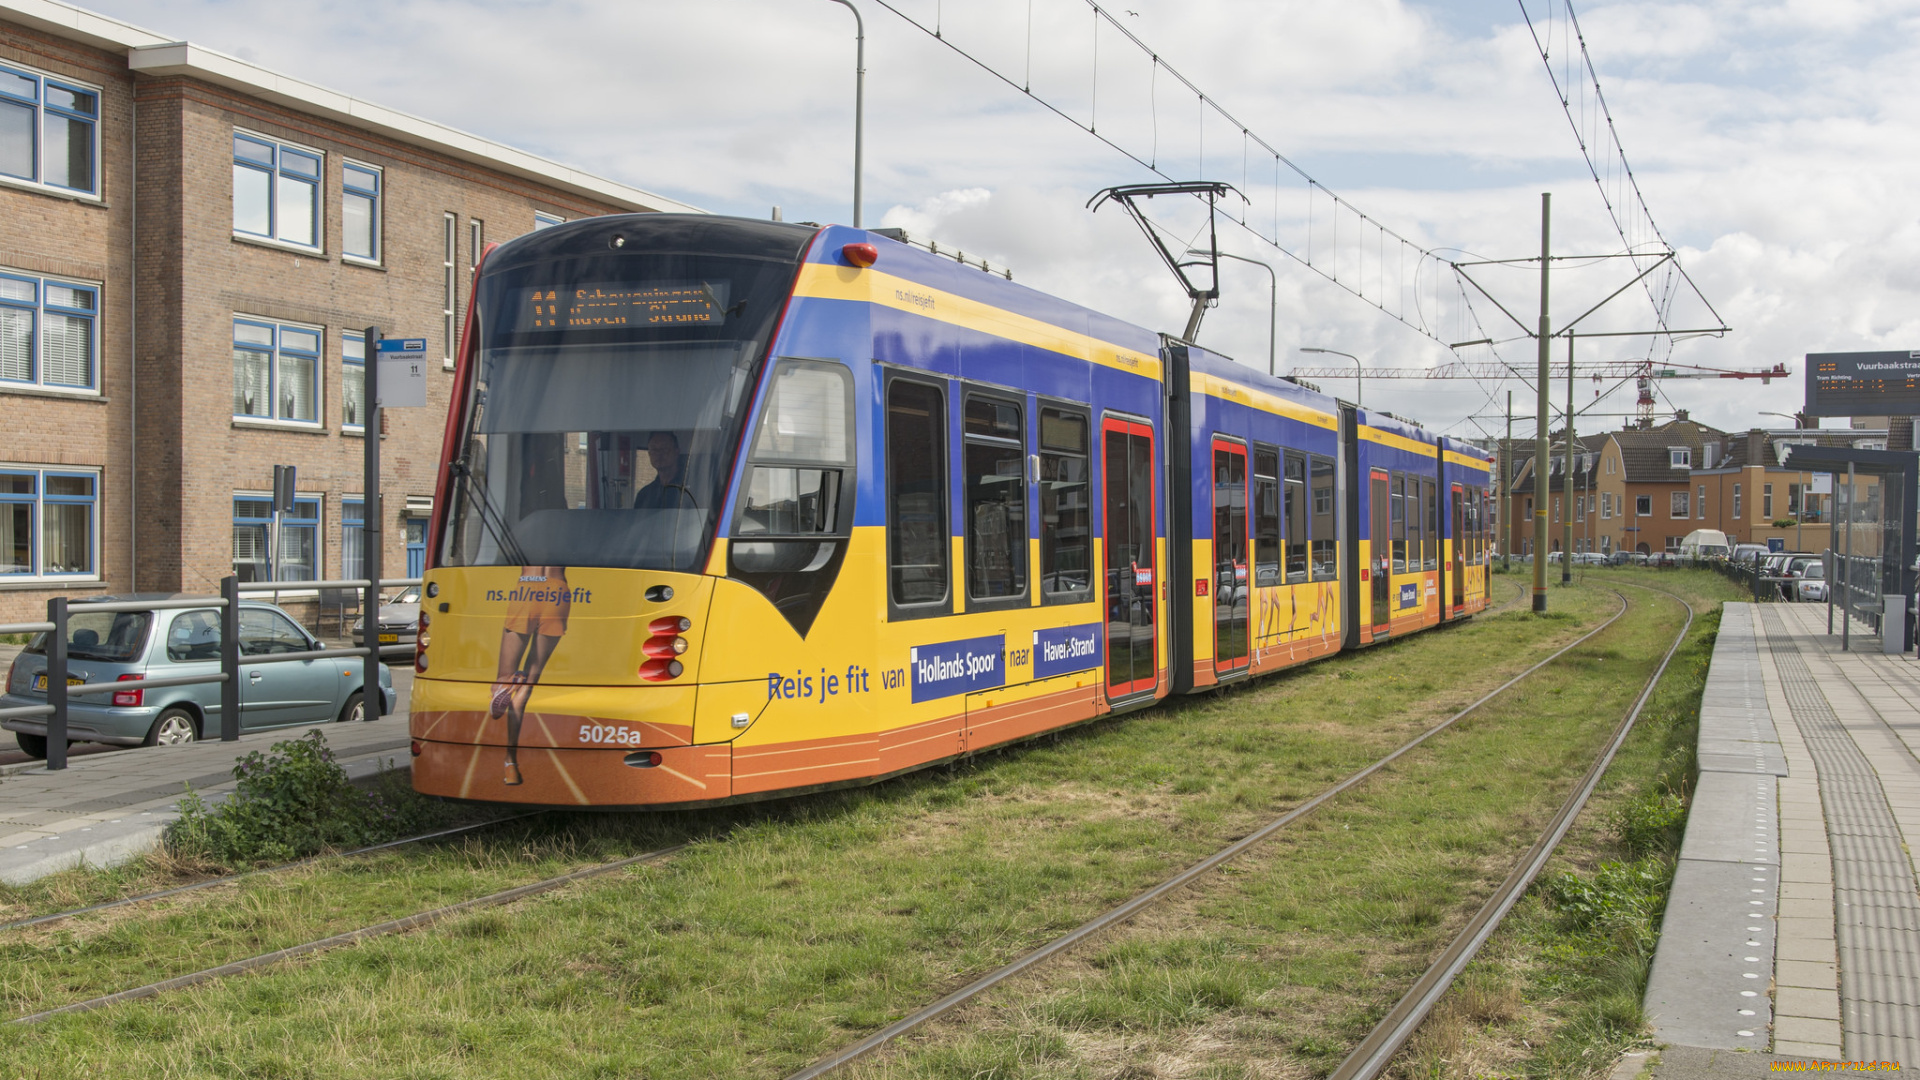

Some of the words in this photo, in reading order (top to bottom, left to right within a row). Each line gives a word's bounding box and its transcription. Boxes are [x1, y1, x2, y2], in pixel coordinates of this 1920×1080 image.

[531, 290, 557, 327] 11
[410, 365, 418, 373] 11
[486, 586, 592, 606] ns.nl/reisjefit
[768, 669, 813, 700] Reis
[819, 667, 839, 704] je
[845, 664, 870, 694] fit
[881, 667, 905, 690] van
[918, 652, 964, 685] Hollands
[966, 651, 996, 681] Spoor
[1009, 648, 1030, 668] naar
[578, 725, 641, 745] 5025a
